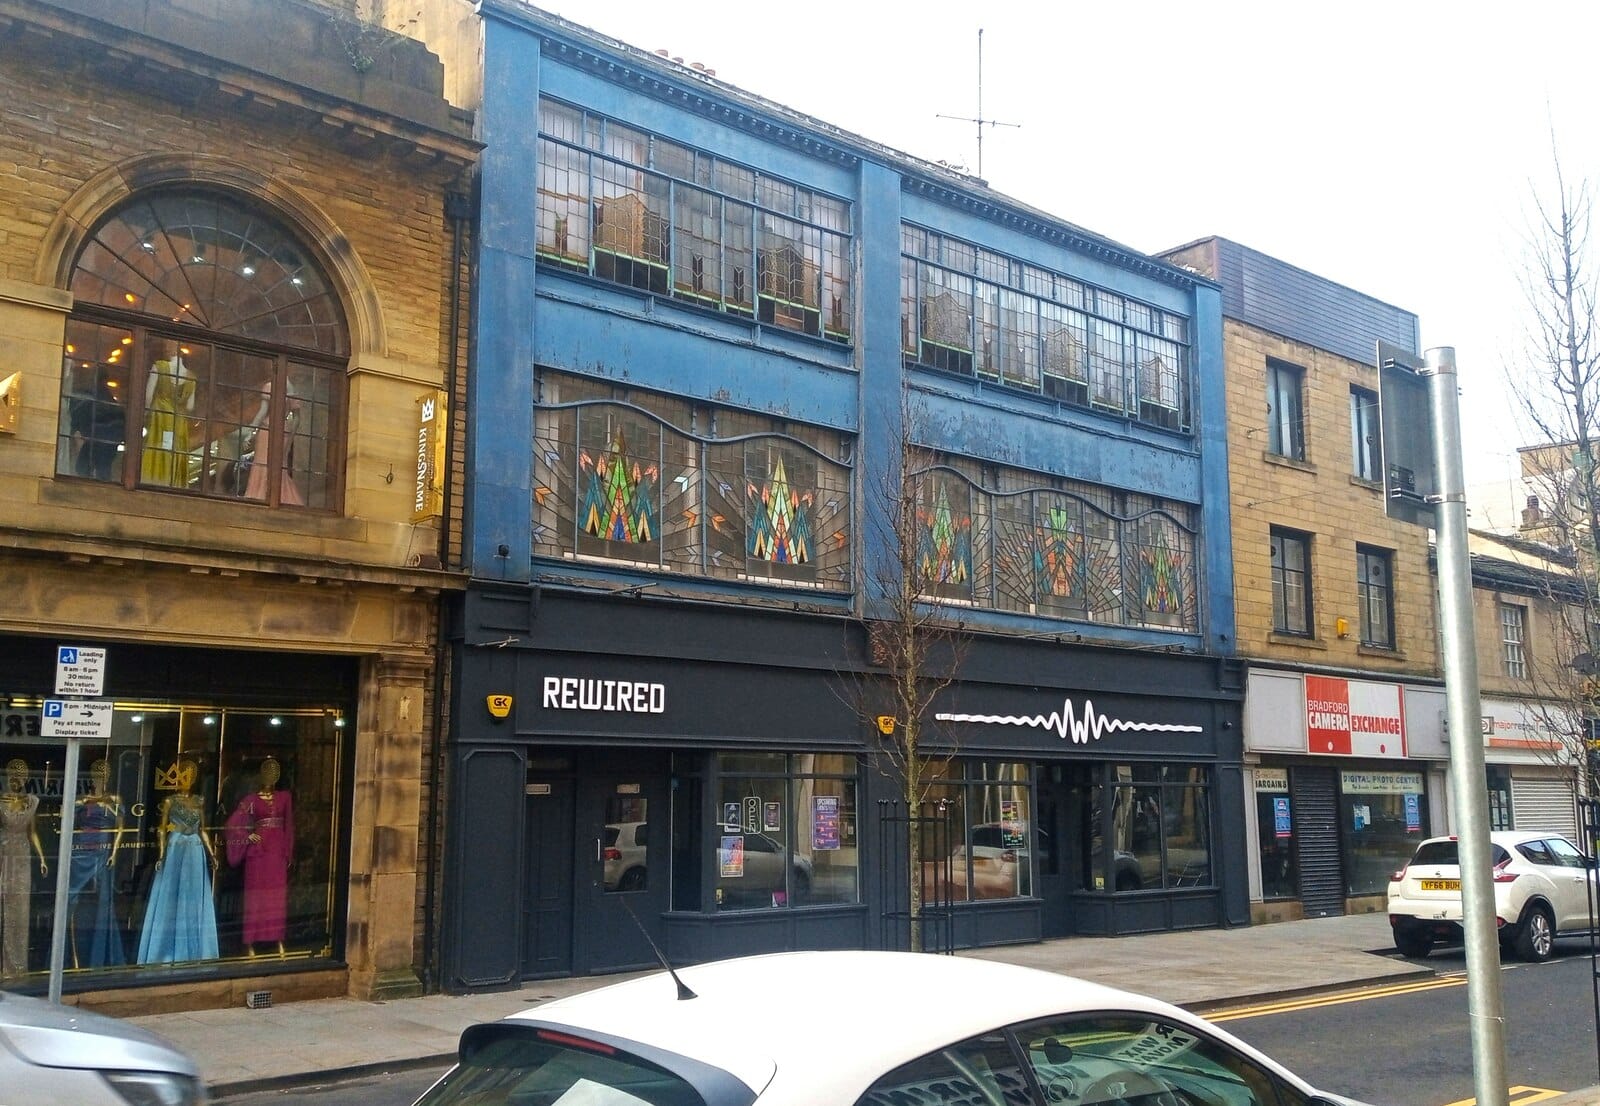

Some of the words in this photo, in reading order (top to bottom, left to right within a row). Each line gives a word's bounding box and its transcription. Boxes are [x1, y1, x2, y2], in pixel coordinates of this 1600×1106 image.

[416, 427, 428, 513] KINGSNAME
[543, 676, 665, 714] REWIRED
[1308, 700, 1349, 714] BRADFORD
[1308, 712, 1350, 732] CAMERA
[1351, 715, 1401, 735] EXCHANGE
[1343, 775, 1371, 784] DIGITAL
[1373, 775, 1393, 784] PHOTO
[1395, 776, 1420, 785] CENTRE
[747, 798, 757, 833] OPEN
